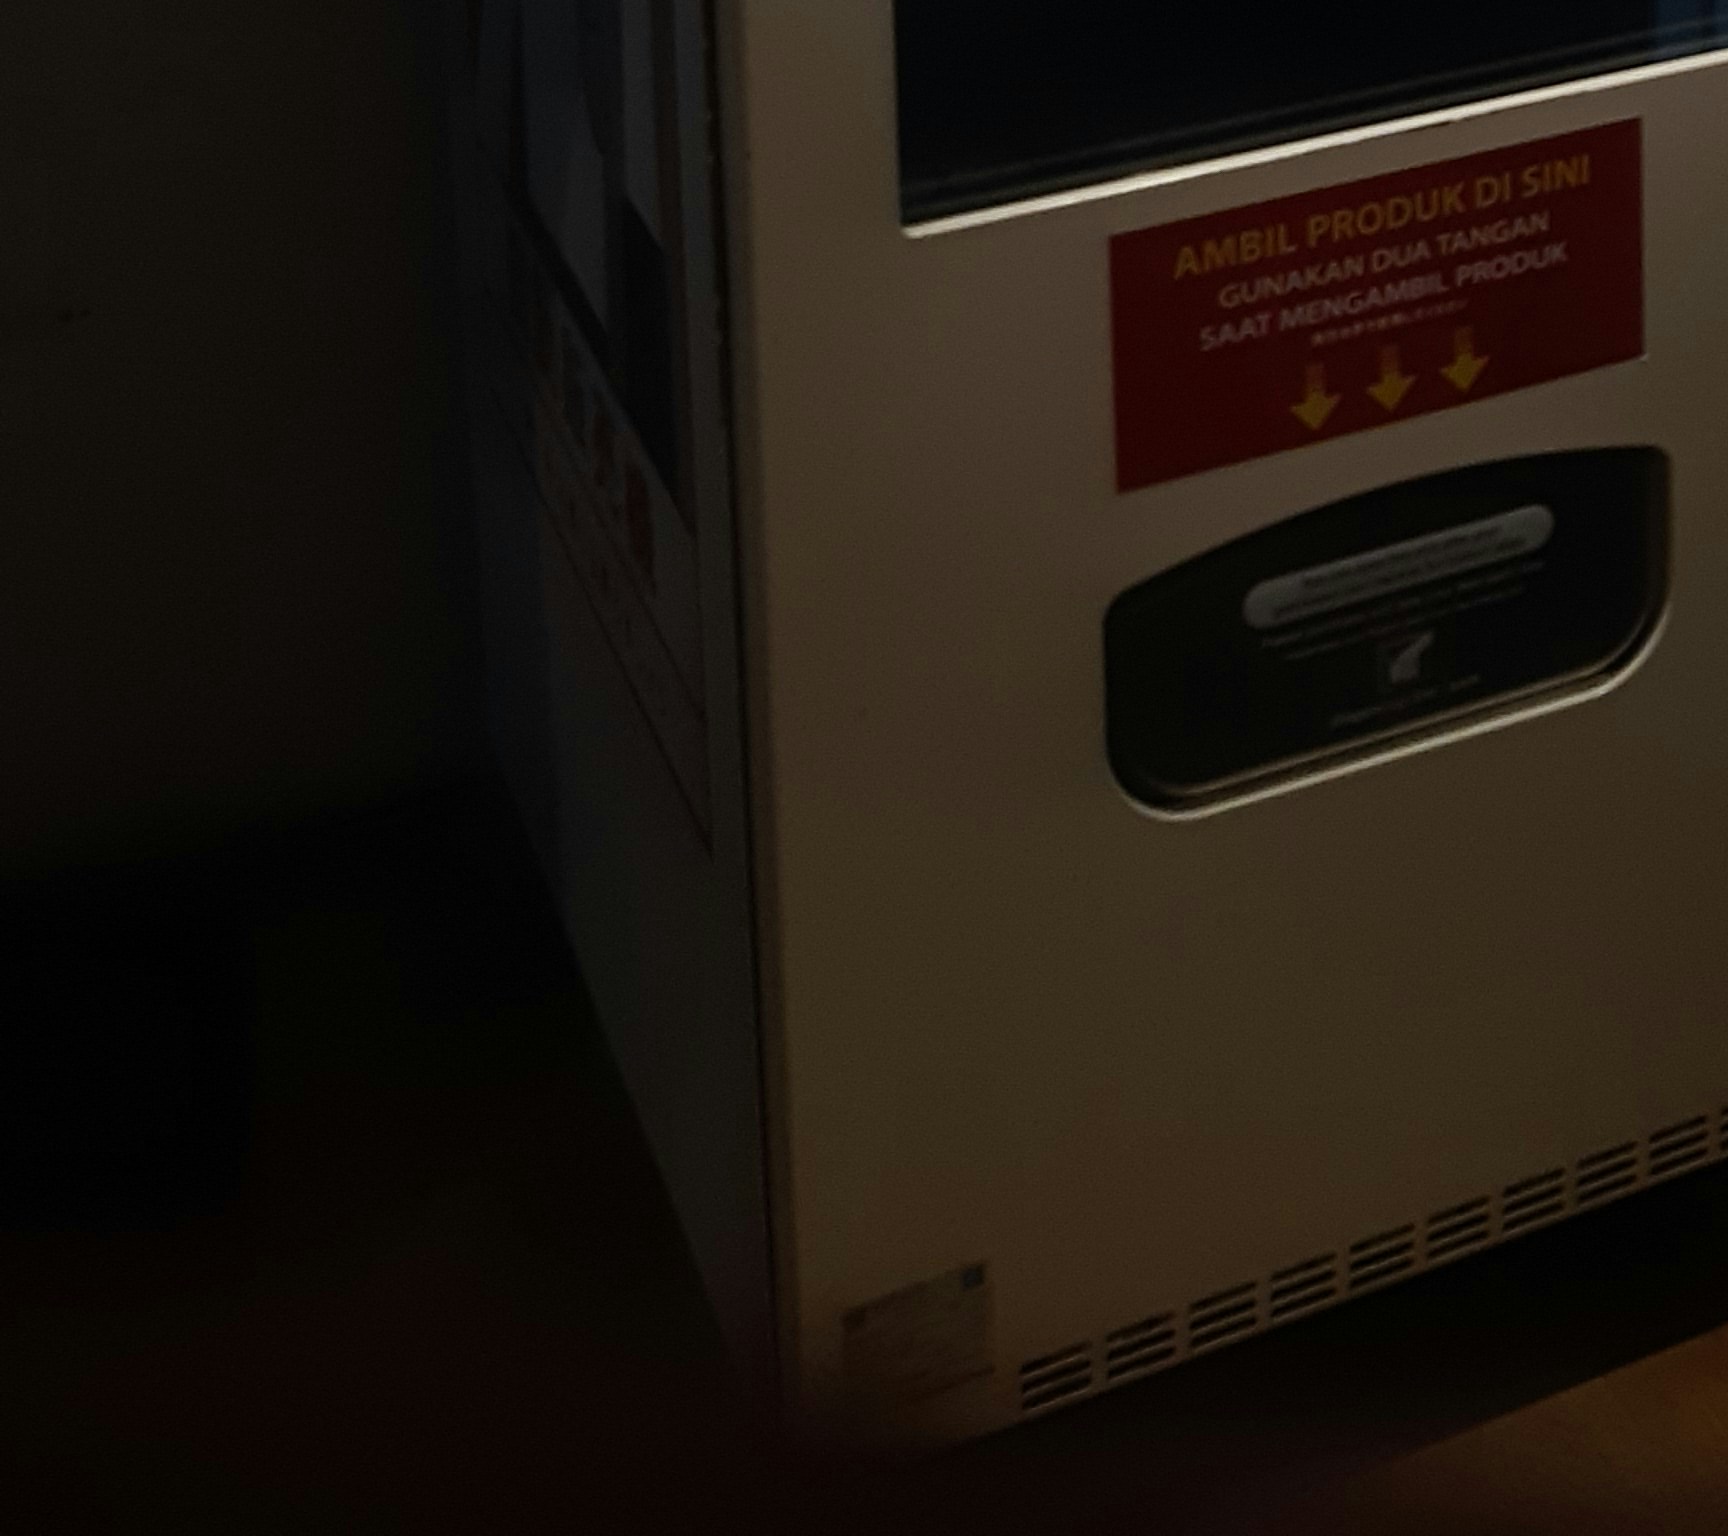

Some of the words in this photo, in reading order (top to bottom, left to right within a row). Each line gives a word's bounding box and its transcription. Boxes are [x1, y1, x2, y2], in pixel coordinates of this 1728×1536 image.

[1173, 224, 1298, 281] AMBIL
[1306, 182, 1468, 249] PRODUK
[1473, 178, 1512, 210] DI
[1520, 153, 1593, 201] SINI
[1217, 252, 1366, 312] GUNAKAN
[1371, 240, 1431, 273] DUA
[1436, 211, 1551, 257] TANGAN
[1200, 313, 1274, 353] SAAT
[1280, 270, 1450, 332] MENGAMBIL
[1455, 241, 1570, 289] PRODUK
